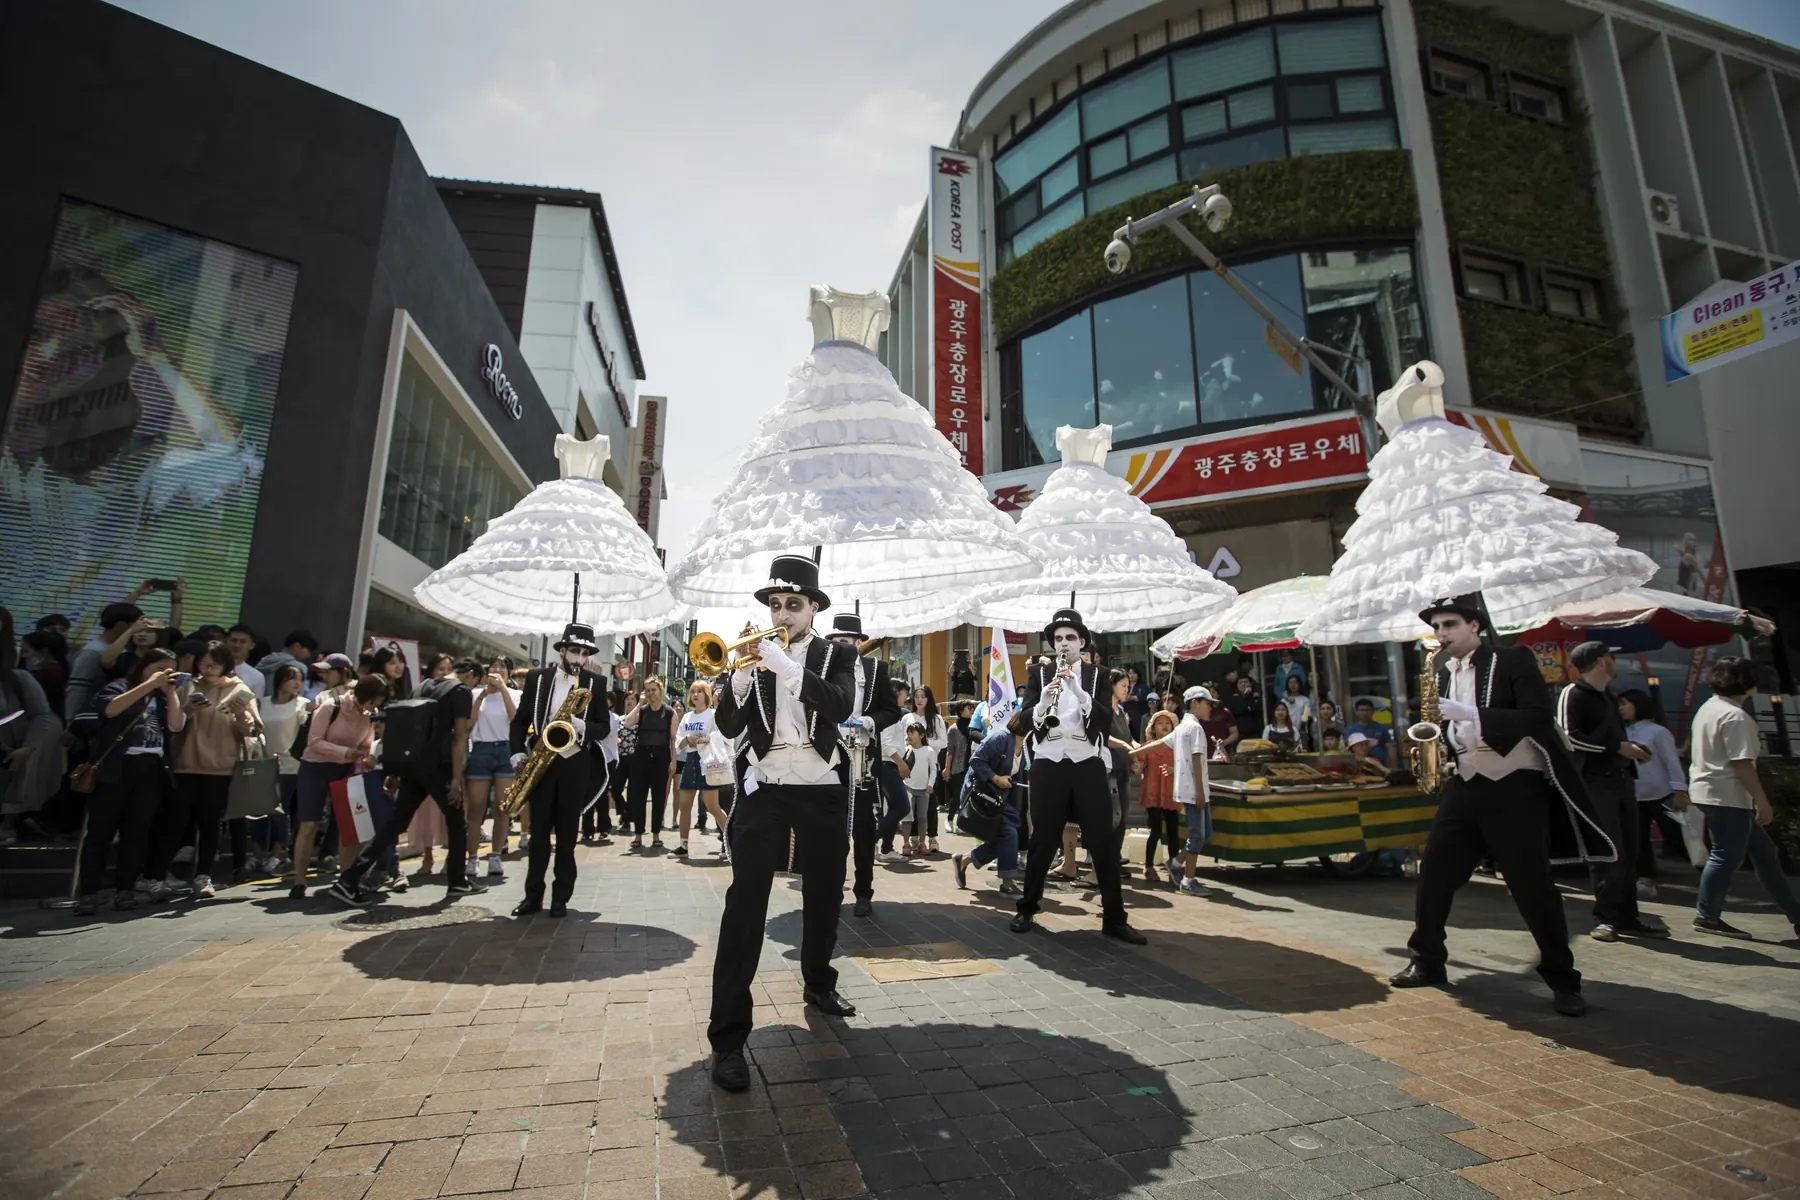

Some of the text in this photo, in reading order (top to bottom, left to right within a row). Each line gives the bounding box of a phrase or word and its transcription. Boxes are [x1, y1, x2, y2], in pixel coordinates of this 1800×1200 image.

[949, 178, 962, 254] KOREA POST
[1692, 292, 1746, 324] Clean
[1748, 271, 1791, 303] 동구,
[1193, 432, 1361, 479] 광주충장로우체
[637, 476, 652, 534] DONUT
